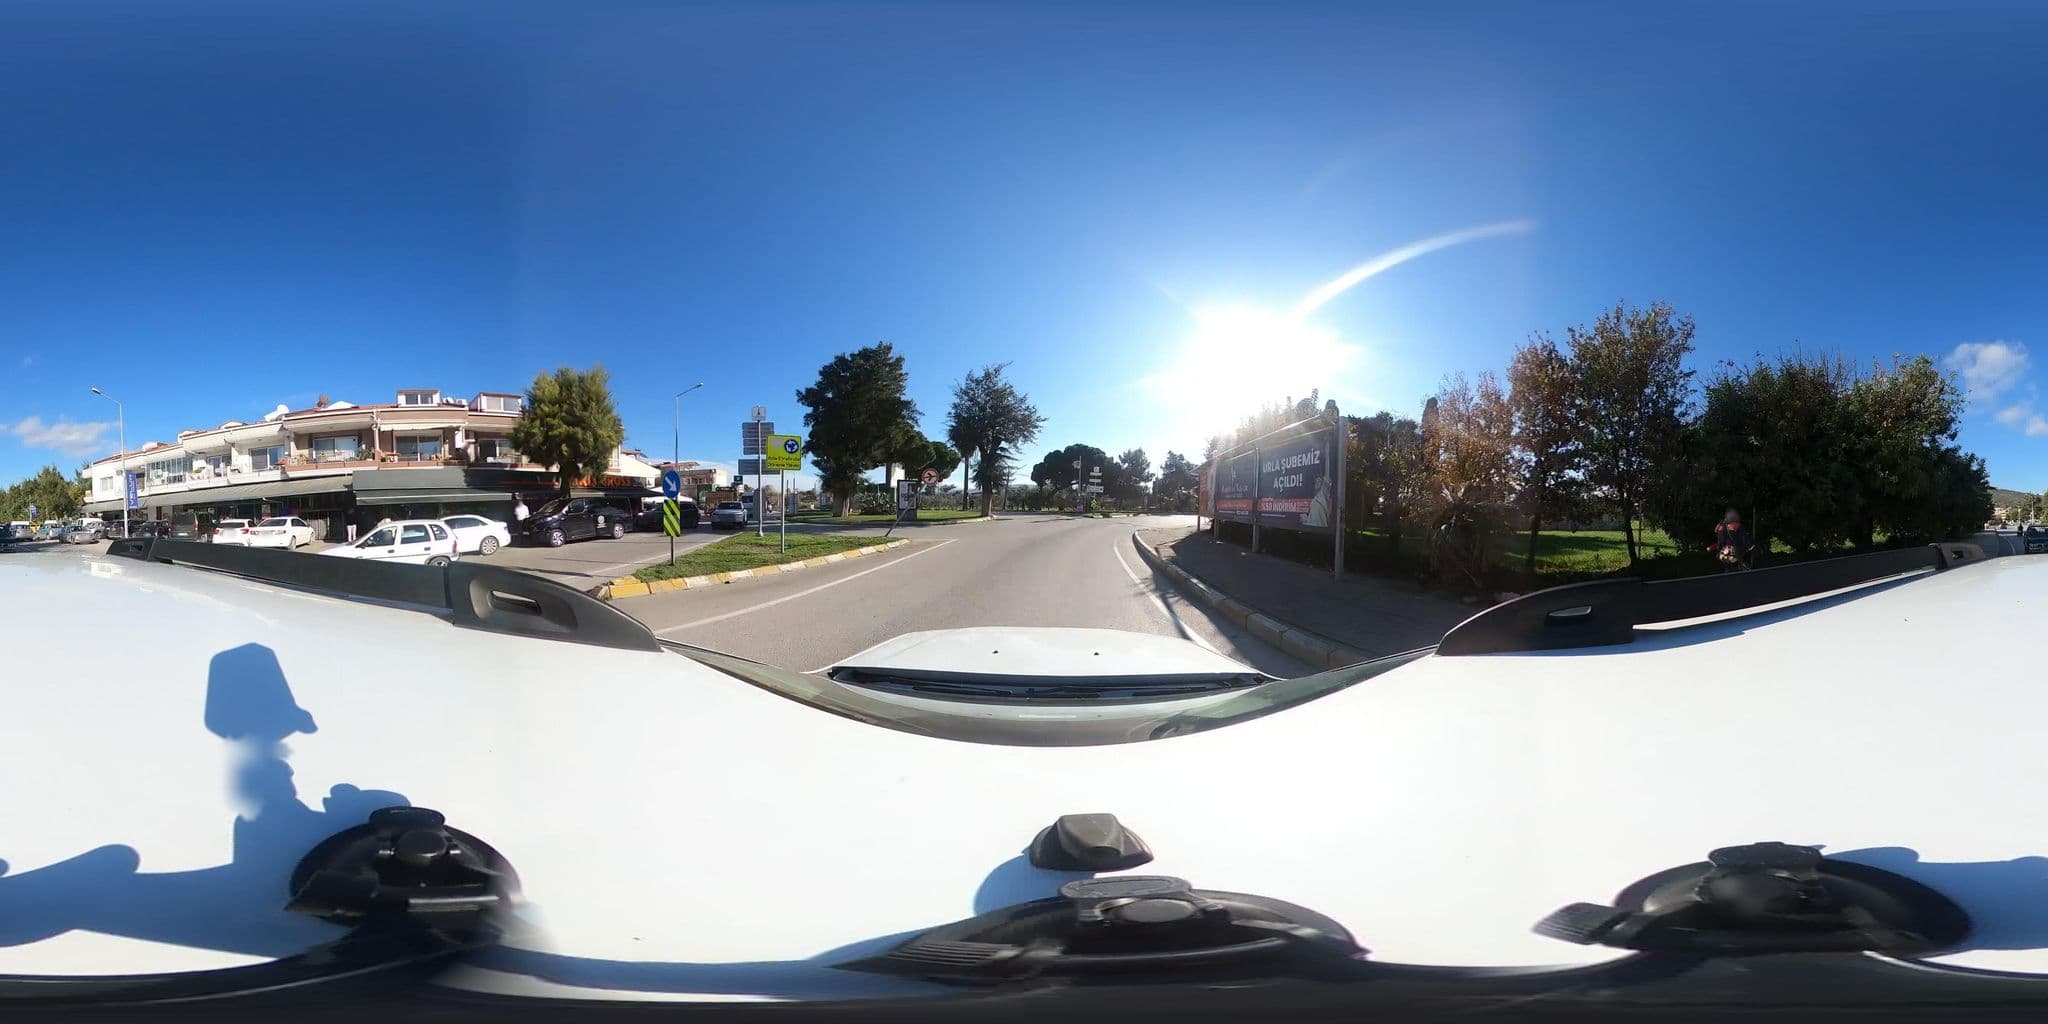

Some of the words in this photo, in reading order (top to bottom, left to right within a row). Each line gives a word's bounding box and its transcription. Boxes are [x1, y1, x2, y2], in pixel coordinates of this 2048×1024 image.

[1263, 460, 1280, 473] URLA
[1281, 448, 1320, 474] ŞUBEMİZ
[1273, 473, 1303, 492] AÇILDI!
